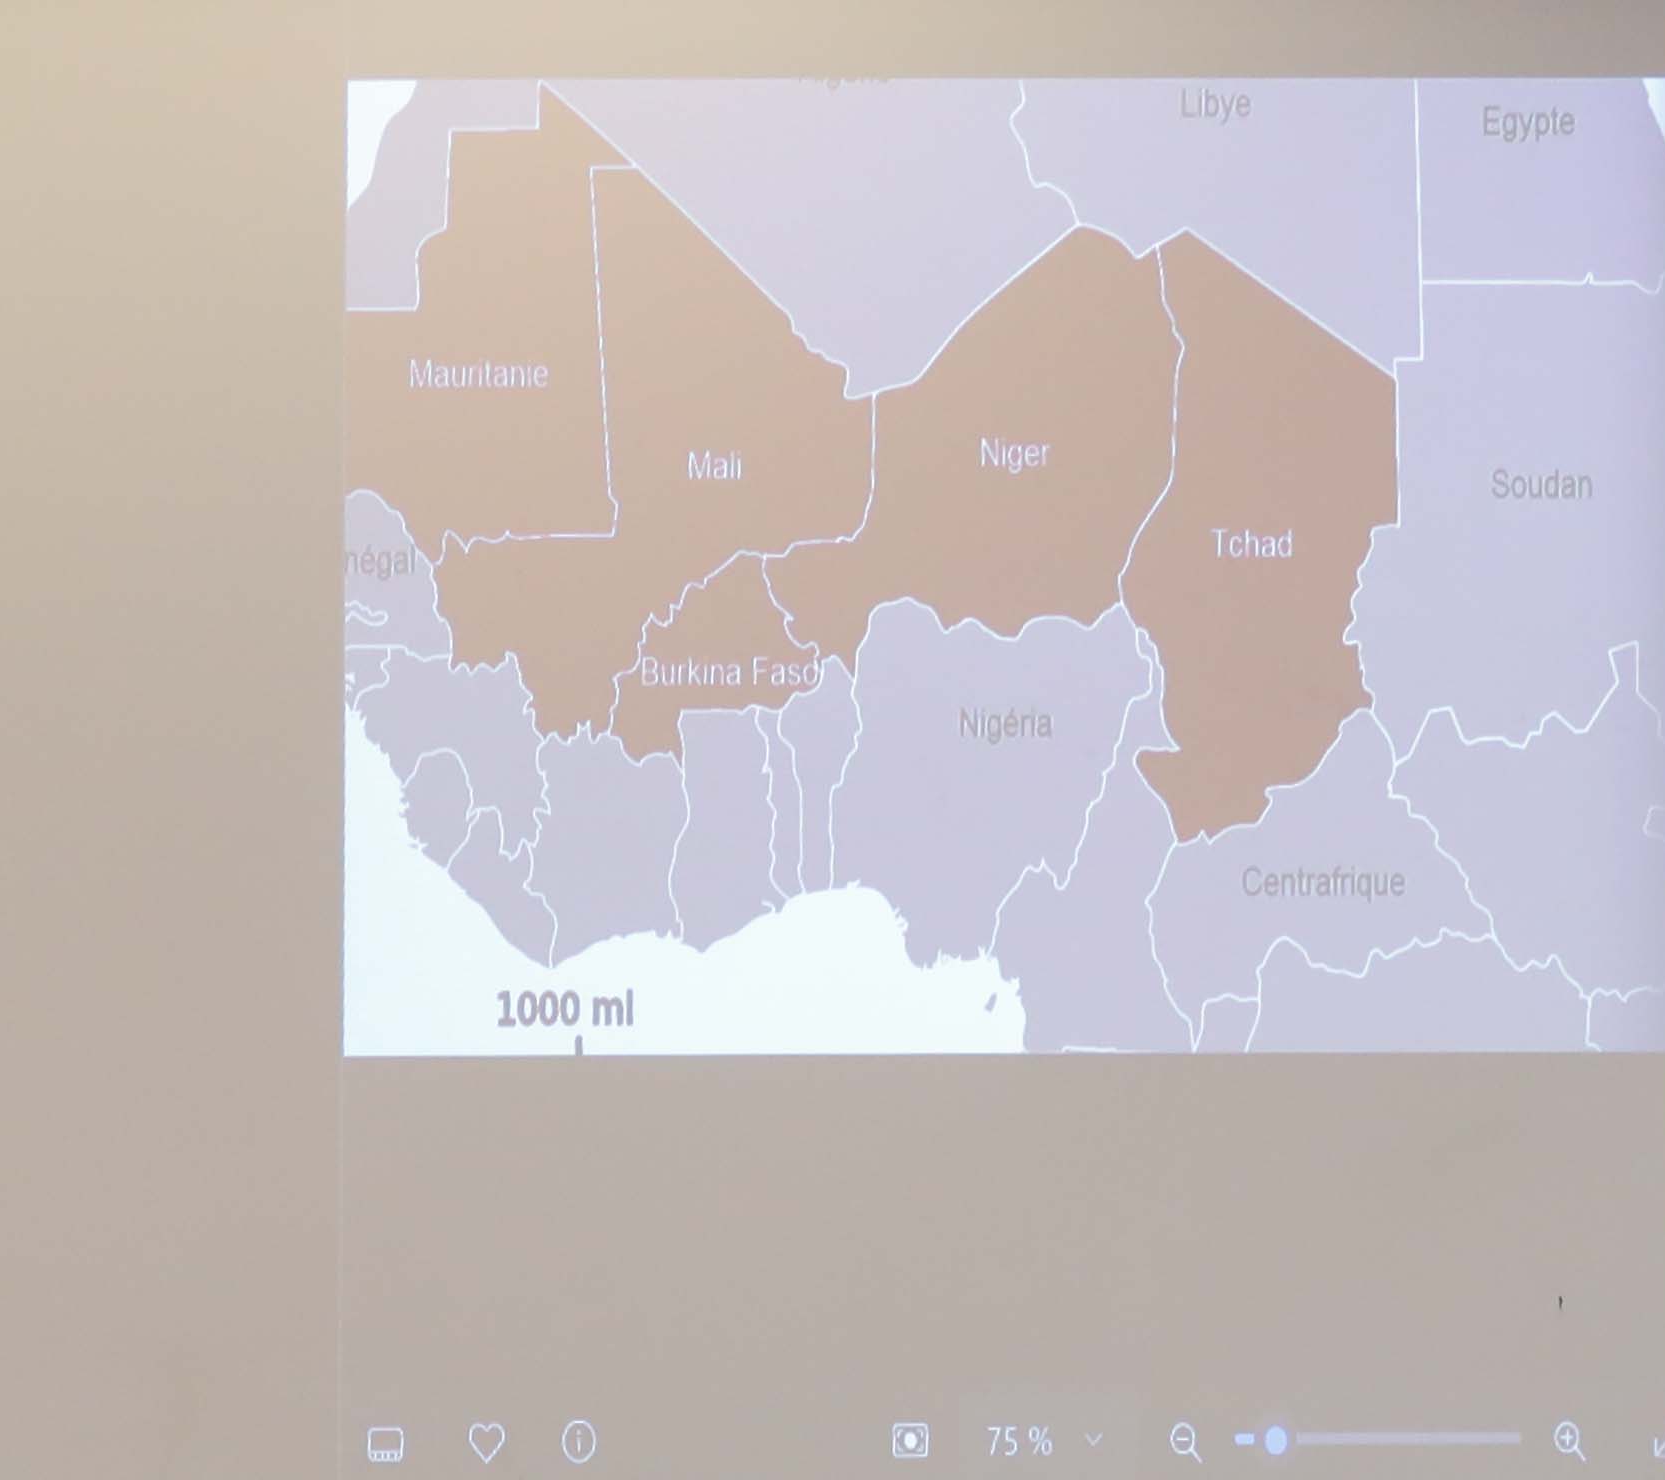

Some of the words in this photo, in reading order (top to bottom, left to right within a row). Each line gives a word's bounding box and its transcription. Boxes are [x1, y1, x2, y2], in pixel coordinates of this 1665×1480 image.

[1182, 88, 1250, 125] Libye
[1483, 105, 1575, 143] Egypte
[410, 360, 547, 387] Mauritanie
[688, 450, 743, 480] Mali
[981, 438, 1049, 473] Niger
[1492, 468, 1593, 499] Soudan
[1216, 529, 1292, 557] Tchad
[641, 653, 741, 686] Burkina
[752, 655, 822, 687] Faso
[960, 708, 1052, 745] Nigéria
[1242, 865, 1405, 904] Centrafrique
[497, 990, 580, 1027] 1000
[988, 1427, 1017, 1455] 75
